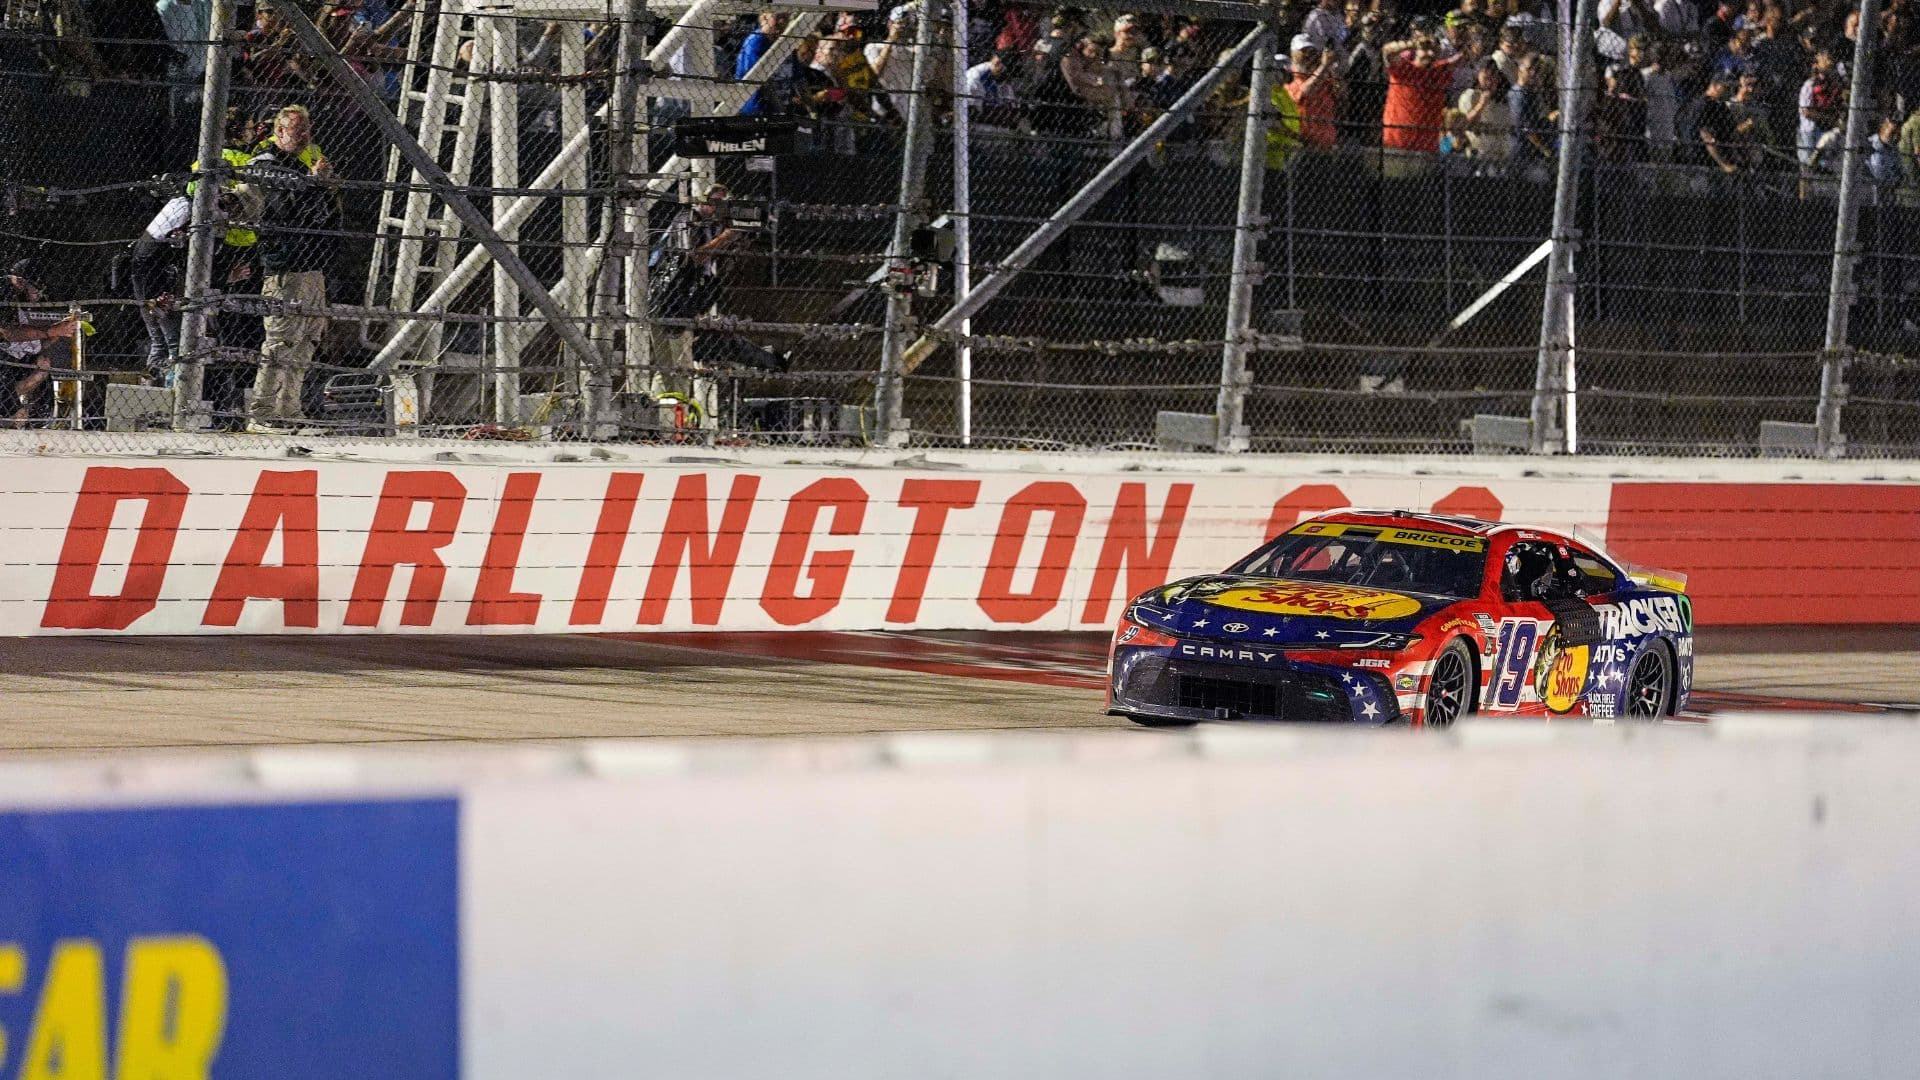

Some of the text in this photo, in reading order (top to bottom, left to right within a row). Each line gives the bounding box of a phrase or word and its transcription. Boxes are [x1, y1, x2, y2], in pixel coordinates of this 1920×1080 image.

[706, 138, 766, 152] WHELEN
[40, 466, 1194, 629] DARLINGTON
[1394, 531, 1477, 548] BRISCOE
[1589, 597, 1683, 640] TRACKER
[1182, 645, 1277, 662] CAMRY
[1592, 645, 1626, 664] ATVs
[1353, 659, 1391, 668] JGR
[1482, 617, 1538, 711] 19
[1553, 670, 1581, 703] Shops
[1589, 704, 1615, 718] COFFEE
[0, 933, 229, 1080] AR
